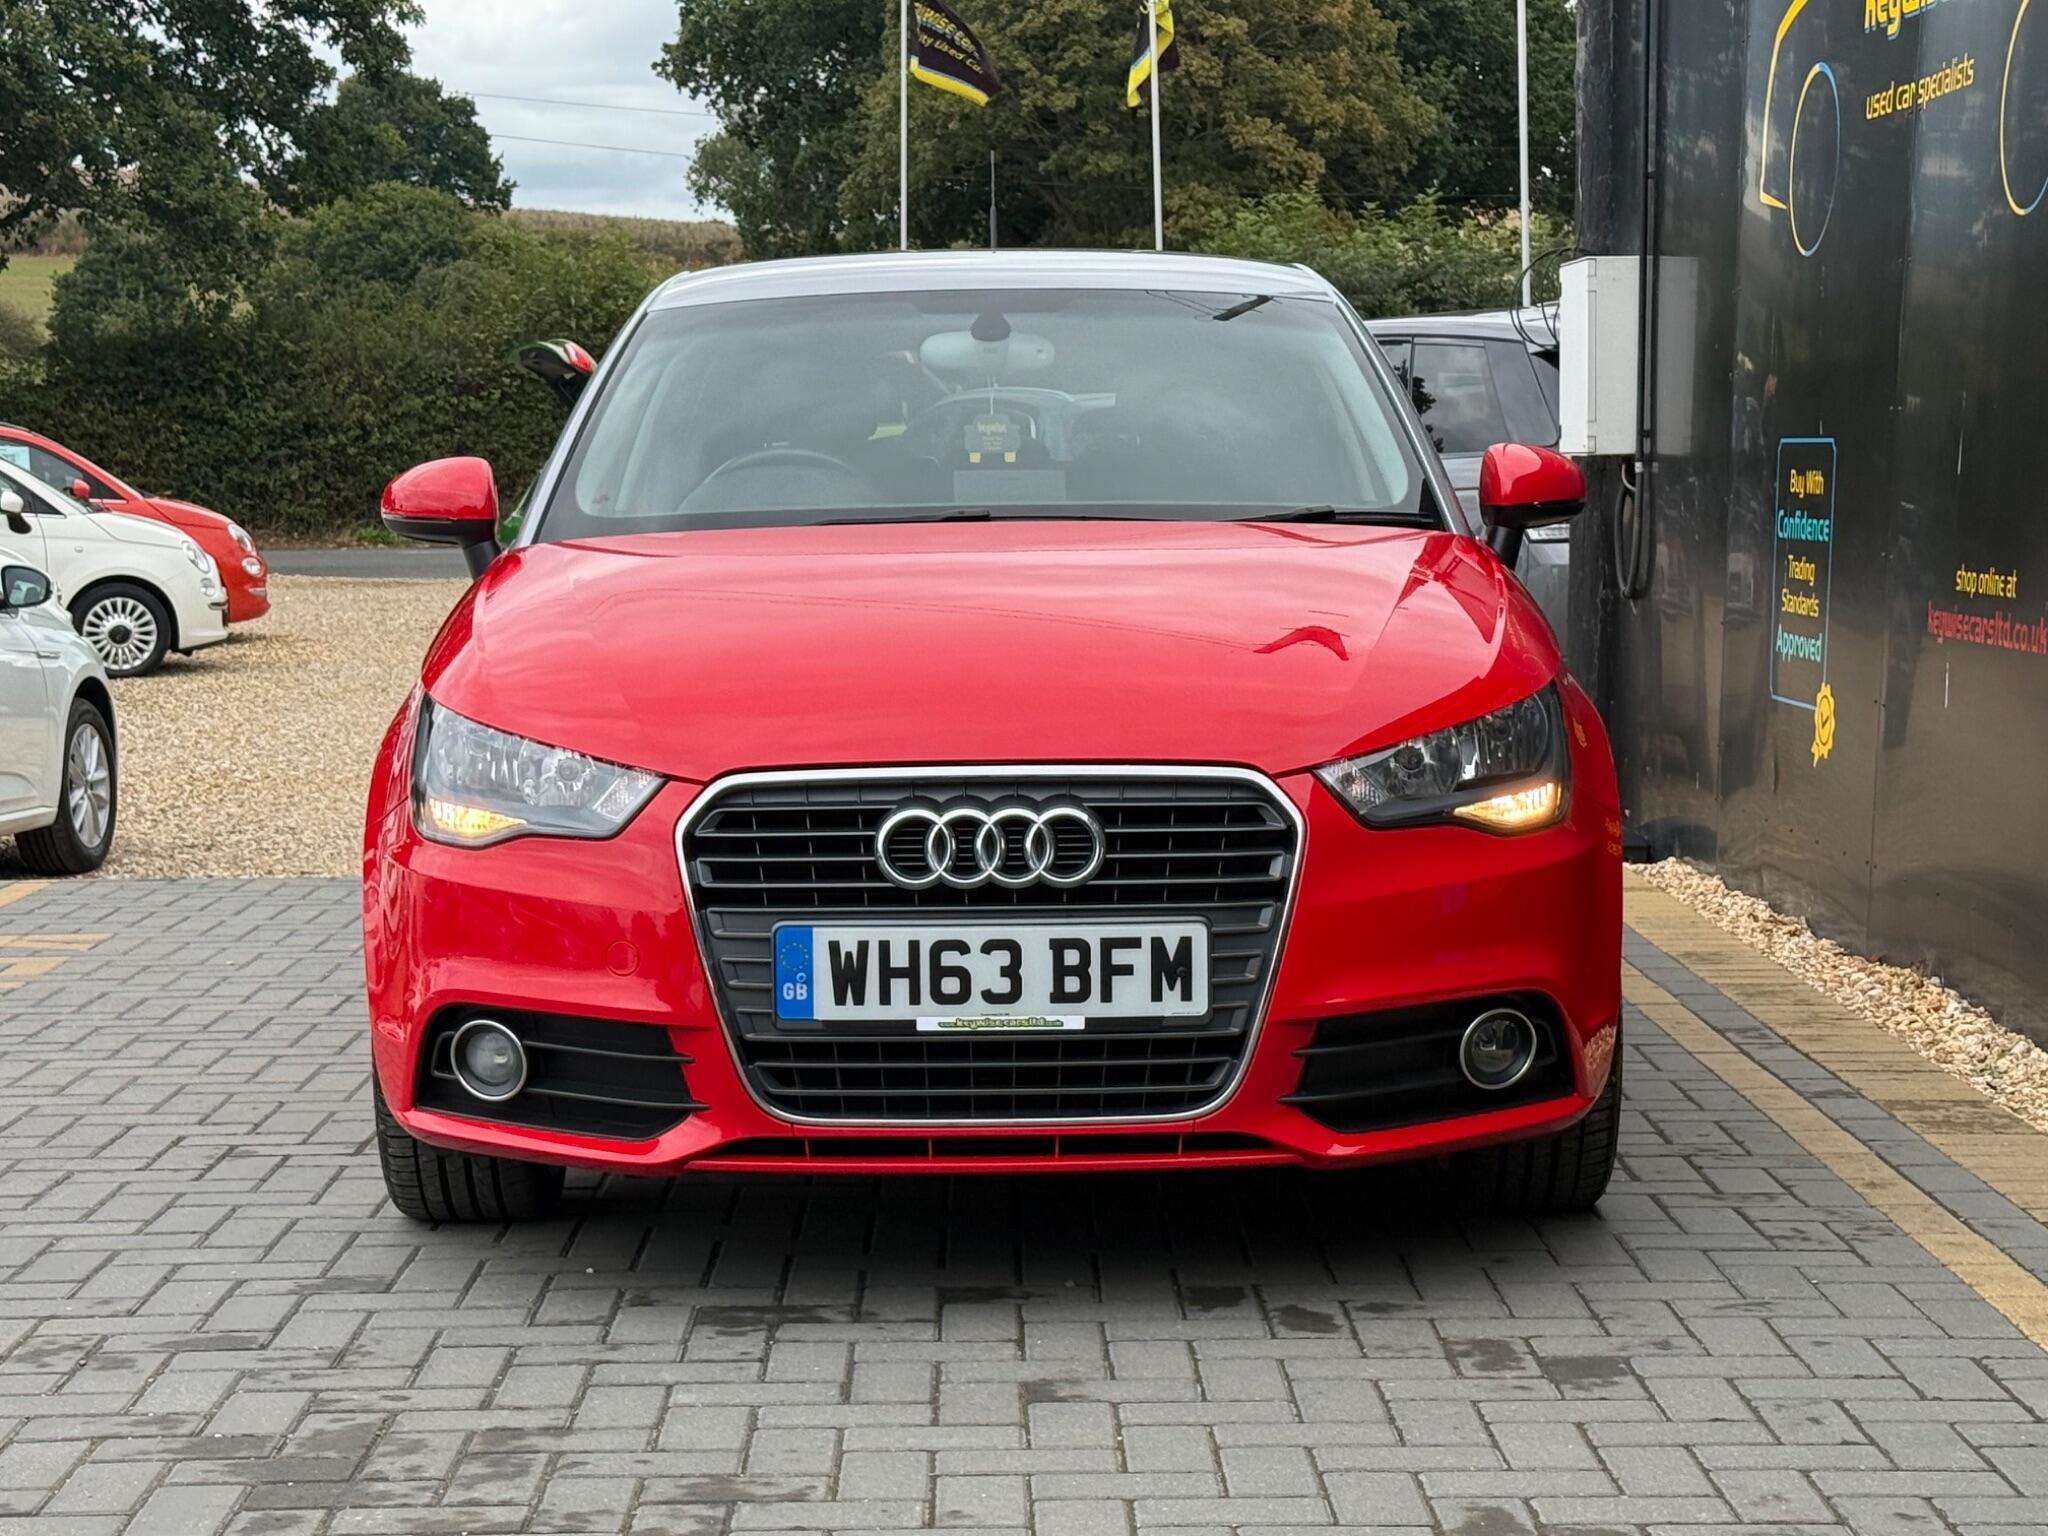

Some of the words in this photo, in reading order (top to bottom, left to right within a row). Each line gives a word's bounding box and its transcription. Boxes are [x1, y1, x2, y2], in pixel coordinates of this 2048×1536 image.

[1866, 80, 1895, 120] used
[1895, 81, 1916, 111] car
[1917, 52, 1975, 109] specialists
[1790, 469, 1805, 498] Buy
[1805, 469, 1824, 496] With
[1777, 508, 1830, 542] Confidence
[1787, 555, 1815, 587] Trading
[1956, 563, 1977, 599] shop
[1978, 567, 2005, 597] online
[2006, 569, 2018, 599] at
[1781, 588, 1819, 618] Standards
[1776, 623, 1822, 663] Approved
[828, 938, 1024, 1006] WH63
[1048, 936, 1194, 1005] BFM
[782, 982, 808, 1001] GB
